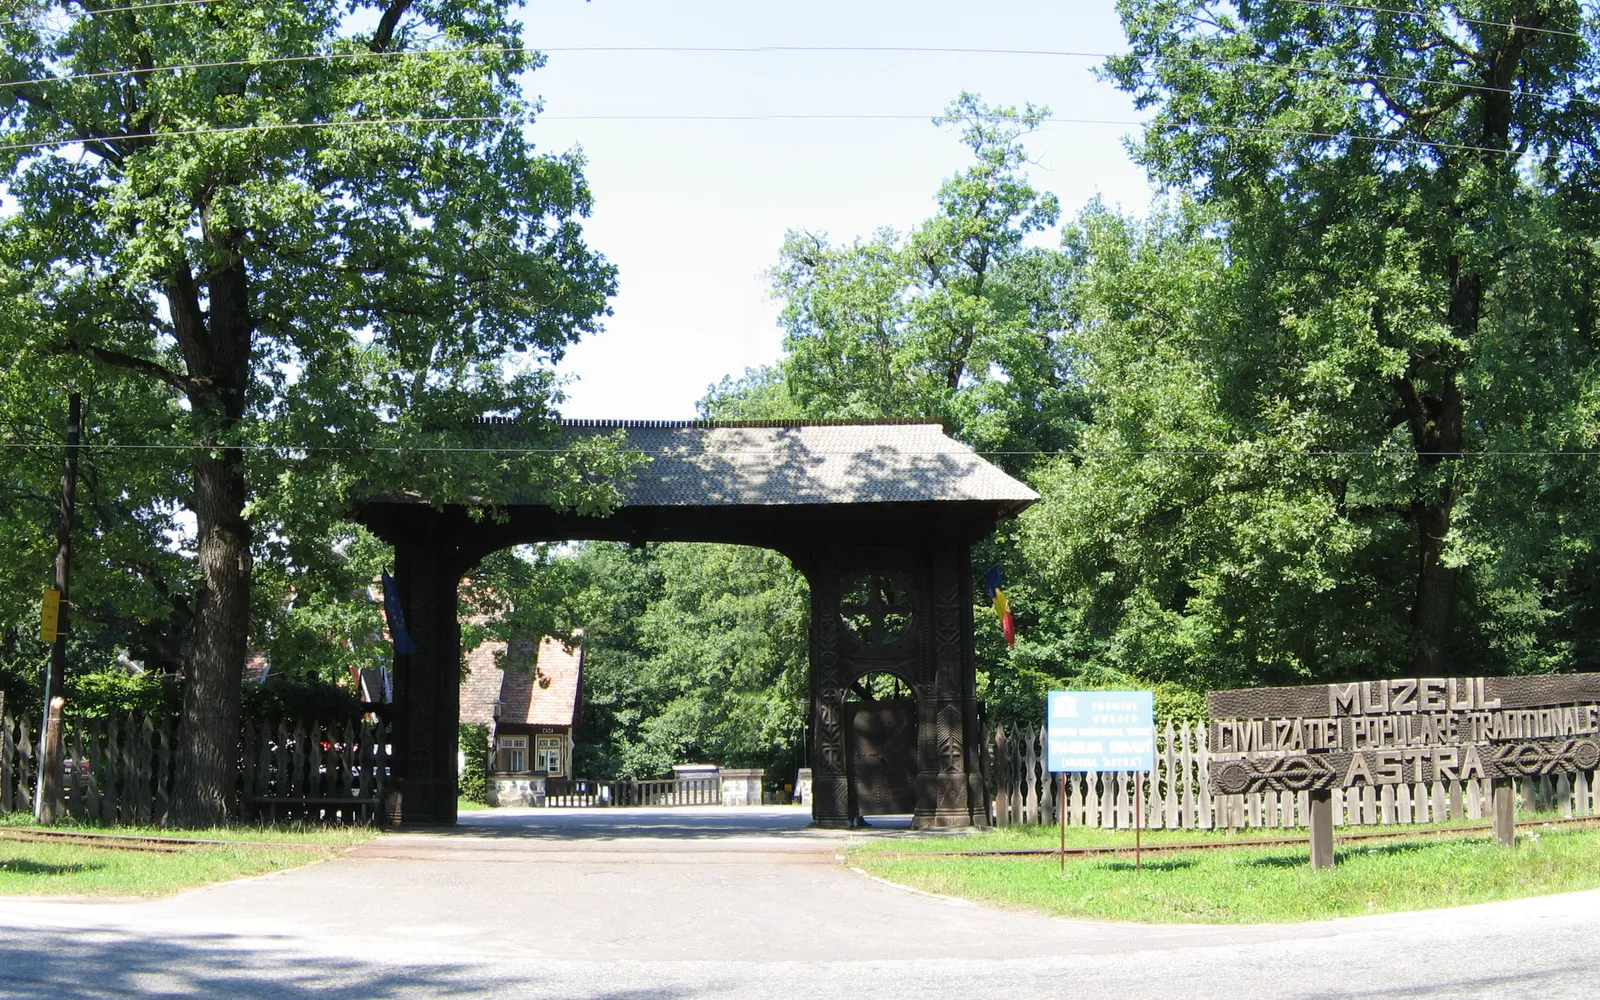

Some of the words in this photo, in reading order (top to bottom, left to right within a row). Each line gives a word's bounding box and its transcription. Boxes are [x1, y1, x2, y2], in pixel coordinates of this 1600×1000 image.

[1329, 677, 1500, 716] MUZEUL
[1352, 713, 1459, 750] POPULARE
[1343, 745, 1486, 788] ASTRA
